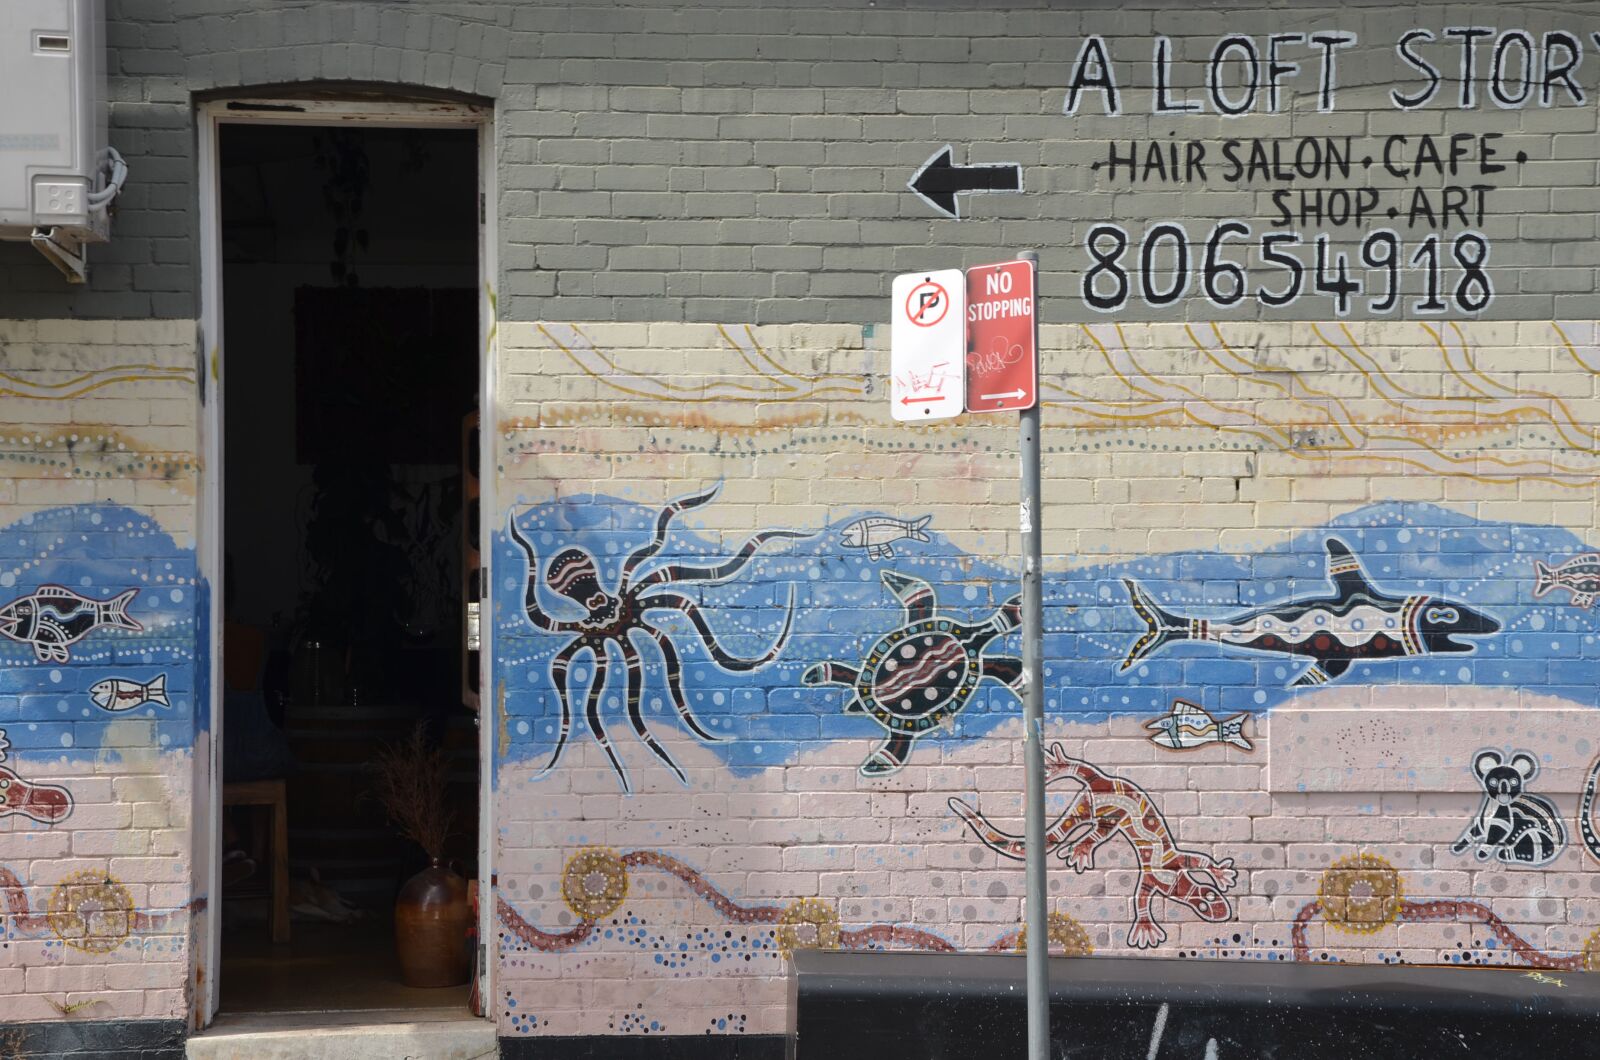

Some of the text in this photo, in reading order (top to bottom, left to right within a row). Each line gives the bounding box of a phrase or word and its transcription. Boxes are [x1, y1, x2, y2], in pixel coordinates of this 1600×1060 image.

[1064, 28, 1600, 117] A LOFT STOR
[1109, 133, 1506, 182] HAIR SALON CAFE
[1270, 185, 1497, 229] SHOP ART
[986, 271, 1013, 295] NO
[1081, 222, 1495, 314] 80654918
[968, 298, 1031, 322] STOPPING
